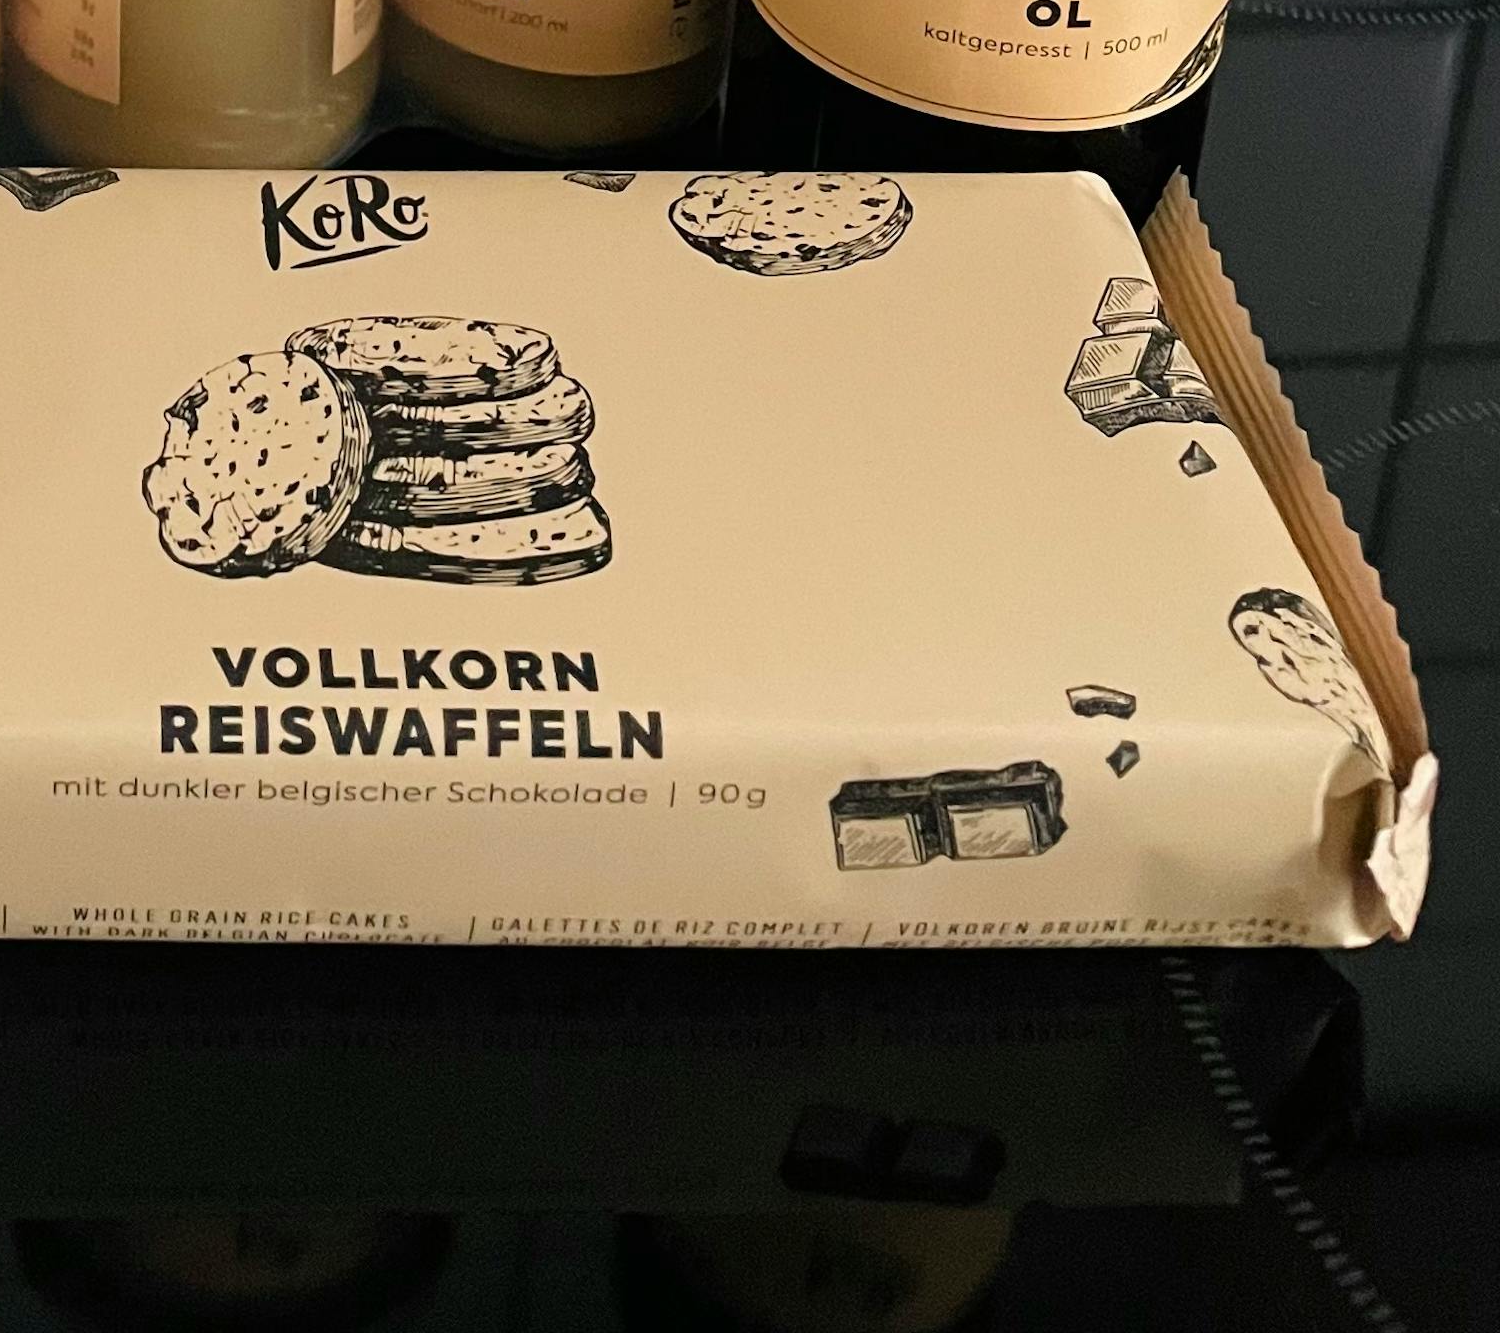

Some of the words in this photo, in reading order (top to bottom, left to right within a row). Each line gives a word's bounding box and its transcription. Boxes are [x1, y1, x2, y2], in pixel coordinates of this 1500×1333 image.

[923, 20, 1074, 61] kaltgepresst
[1103, 36, 1141, 55] 500
[1147, 28, 1168, 47] ml
[261, 174, 428, 271] KoRo
[212, 647, 599, 692] VOLLKORN
[160, 705, 663, 759] REISWAFFELN
[54, 777, 106, 797] mit
[119, 777, 245, 799] dunkler
[258, 779, 436, 806] belgischer
[447, 782, 647, 804] Schokolade
[74, 908, 153, 922] WHOLE
[170, 910, 246, 924] GRAIN
[261, 911, 315, 925] RICE
[329, 913, 408, 929] CAKES
[492, 917, 620, 933] GALETTES
[634, 921, 659, 934] DE
[676, 921, 714, 934] RIZ
[727, 922, 842, 935] COMPLET
[900, 921, 1029, 936] VOLKOREN
